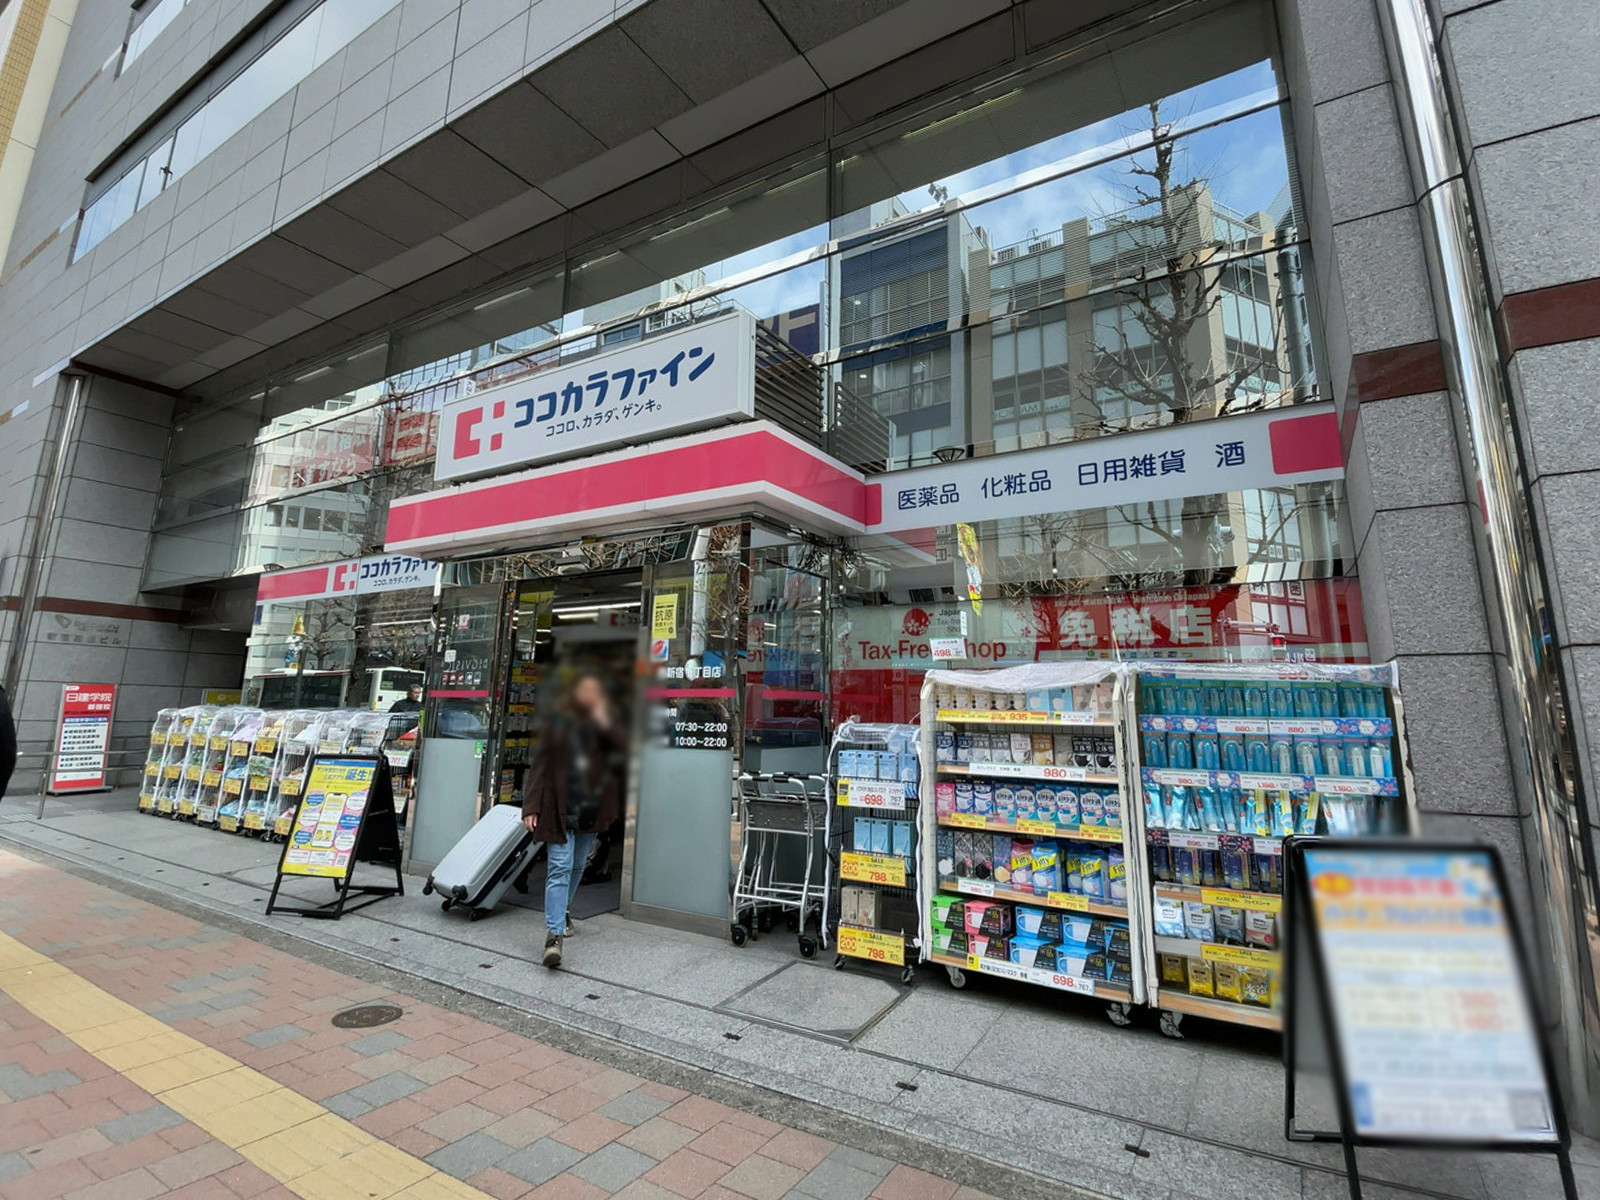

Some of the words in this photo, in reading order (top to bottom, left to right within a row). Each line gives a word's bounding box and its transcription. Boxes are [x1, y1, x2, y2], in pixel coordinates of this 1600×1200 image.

[514, 346, 715, 428] ココカラファイン
[546, 399, 662, 437] ココロ、カラダ、ゲンキ。
[898, 483, 960, 510] 医薬品
[981, 469, 1051, 498] 化粧品
[1078, 449, 1186, 486] 日用雑貨
[1215, 441, 1245, 467] 酒
[1058, 604, 1213, 647] 免税店
[858, 639, 930, 661] Tax-Fre
[964, 638, 1007, 662] hop
[1043, 768, 1067, 778] 980
[864, 793, 883, 806] 698
[868, 870, 887, 881] 798
[866, 947, 885, 959] 798
[1052, 974, 1075, 988] 698
